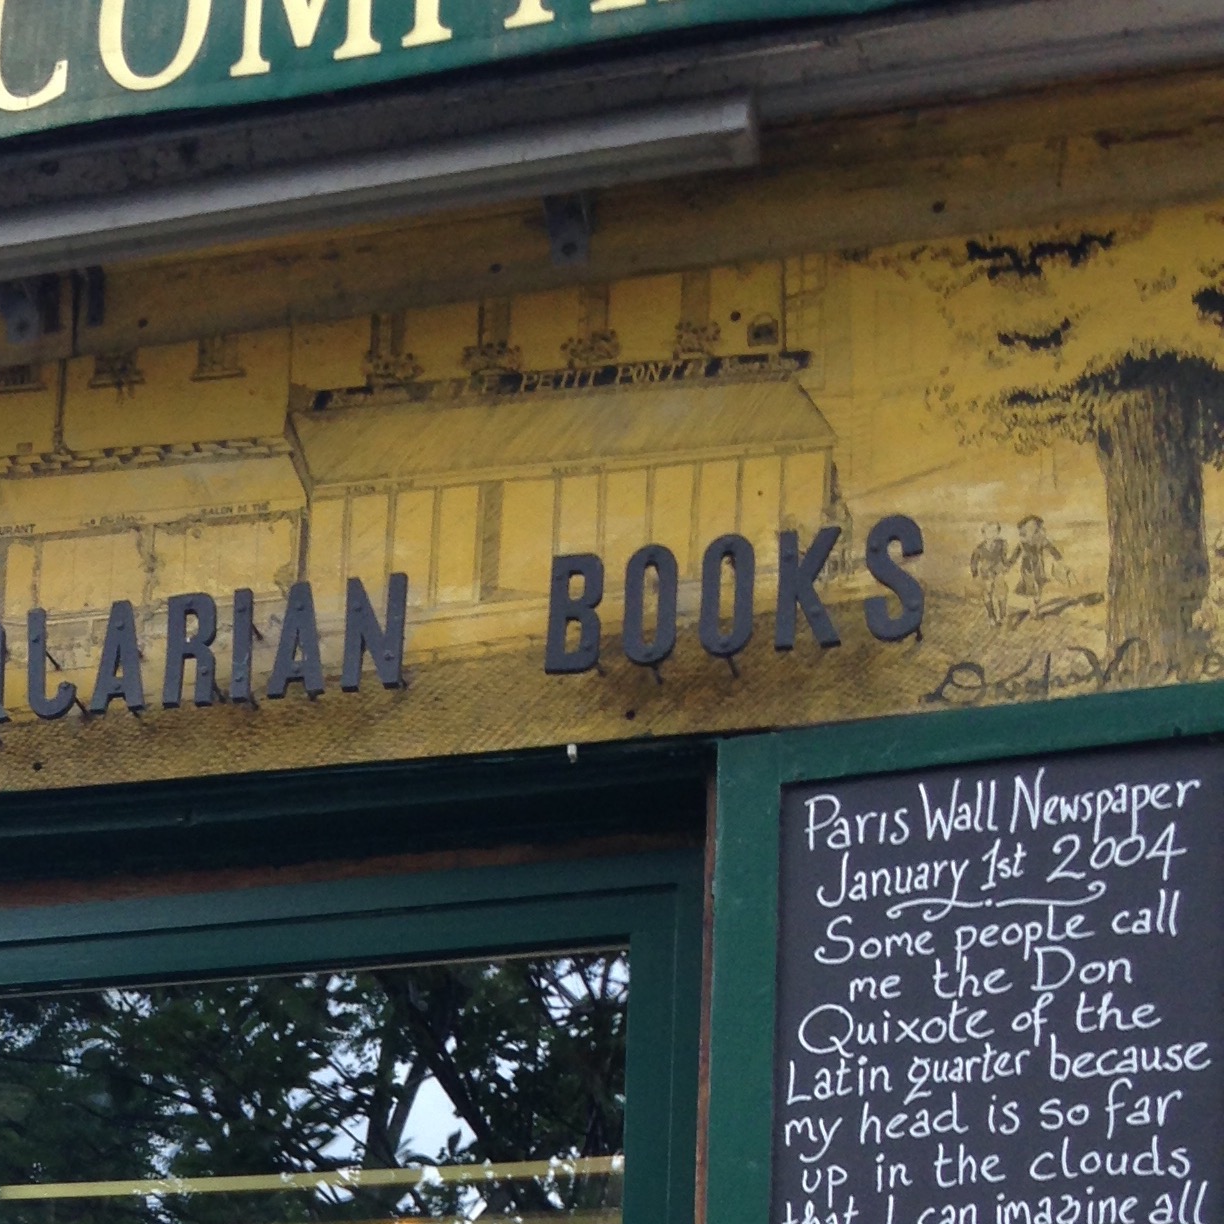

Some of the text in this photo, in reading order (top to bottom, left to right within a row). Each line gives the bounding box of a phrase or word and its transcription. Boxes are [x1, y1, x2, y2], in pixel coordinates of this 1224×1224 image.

[545, 515, 924, 675] BOOKS
[805, 767, 1200, 851] Paris Wall Newspaper
[816, 822, 1187, 922] January 1st 2004
[814, 889, 1180, 974] Some people call
[850, 946, 1132, 1002] me the Don
[798, 991, 1161, 1058] Quixote of the
[787, 1033, 1211, 1105] Latin quarter because
[802, 1135, 1190, 1208] up in the clouds
